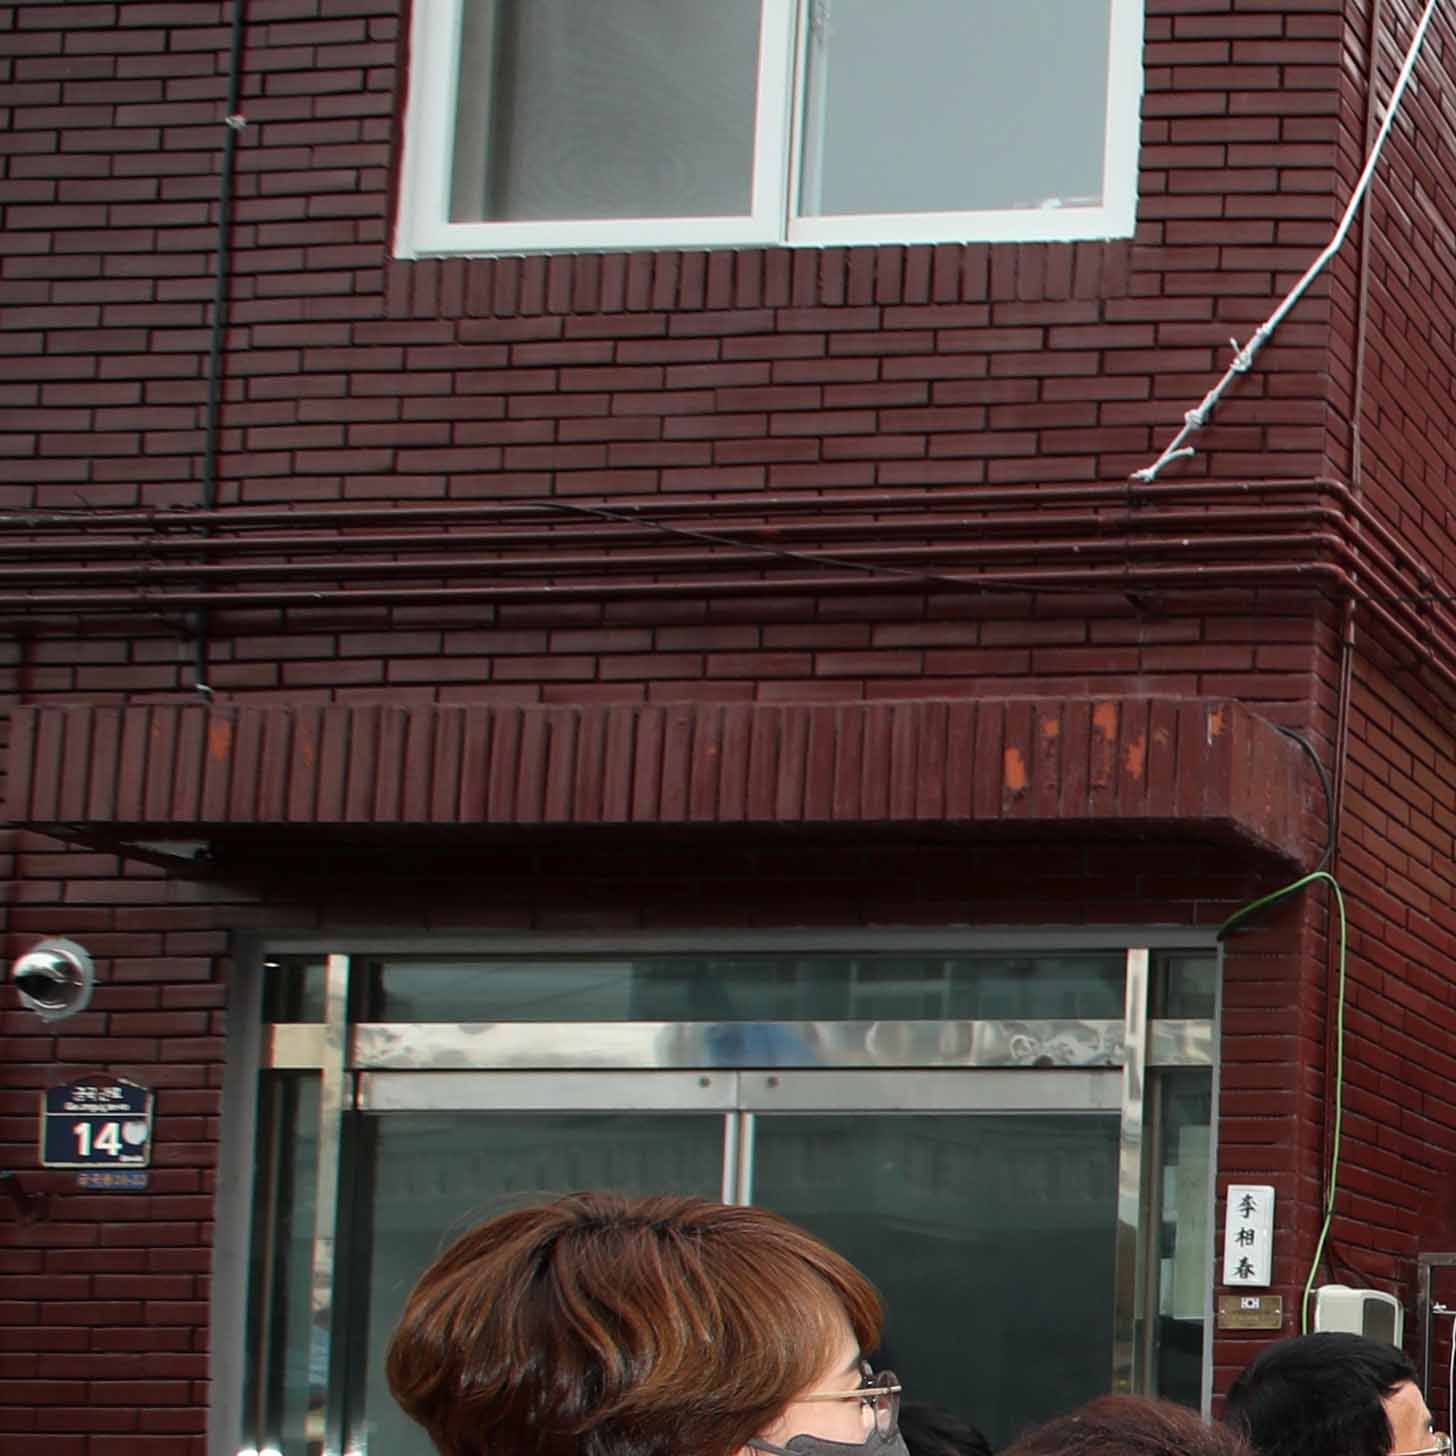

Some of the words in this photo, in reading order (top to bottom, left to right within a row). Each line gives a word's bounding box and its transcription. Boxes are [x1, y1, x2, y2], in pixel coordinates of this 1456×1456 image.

[72, 1121, 123, 1156] 14
[1234, 1194, 1258, 1280] 李相春
